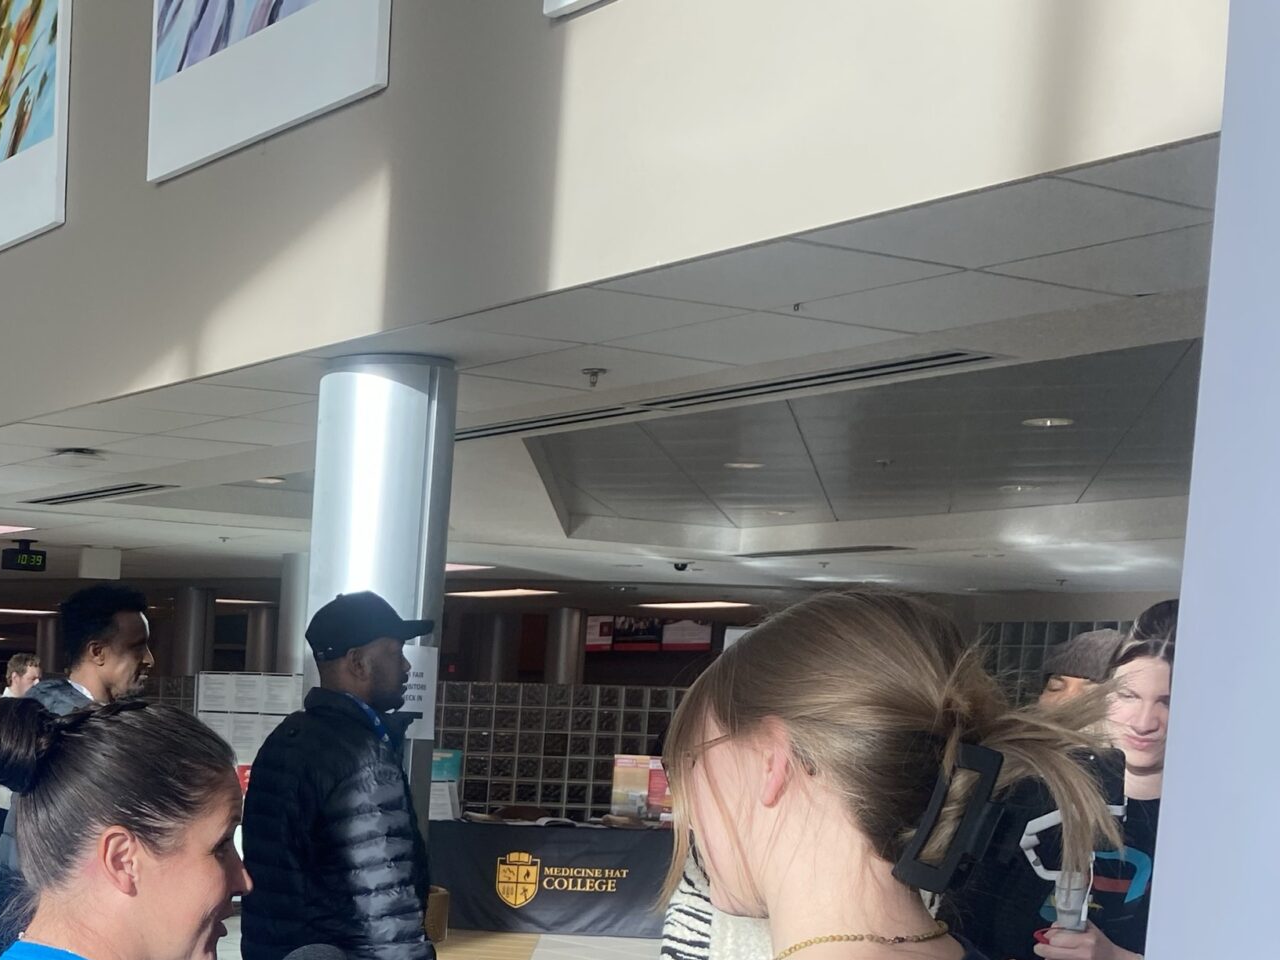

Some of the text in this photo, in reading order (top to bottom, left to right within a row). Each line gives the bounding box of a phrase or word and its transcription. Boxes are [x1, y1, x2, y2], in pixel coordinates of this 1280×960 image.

[543, 866, 629, 878] MEDICINE HAT
[542, 876, 617, 892] COLLEGE
